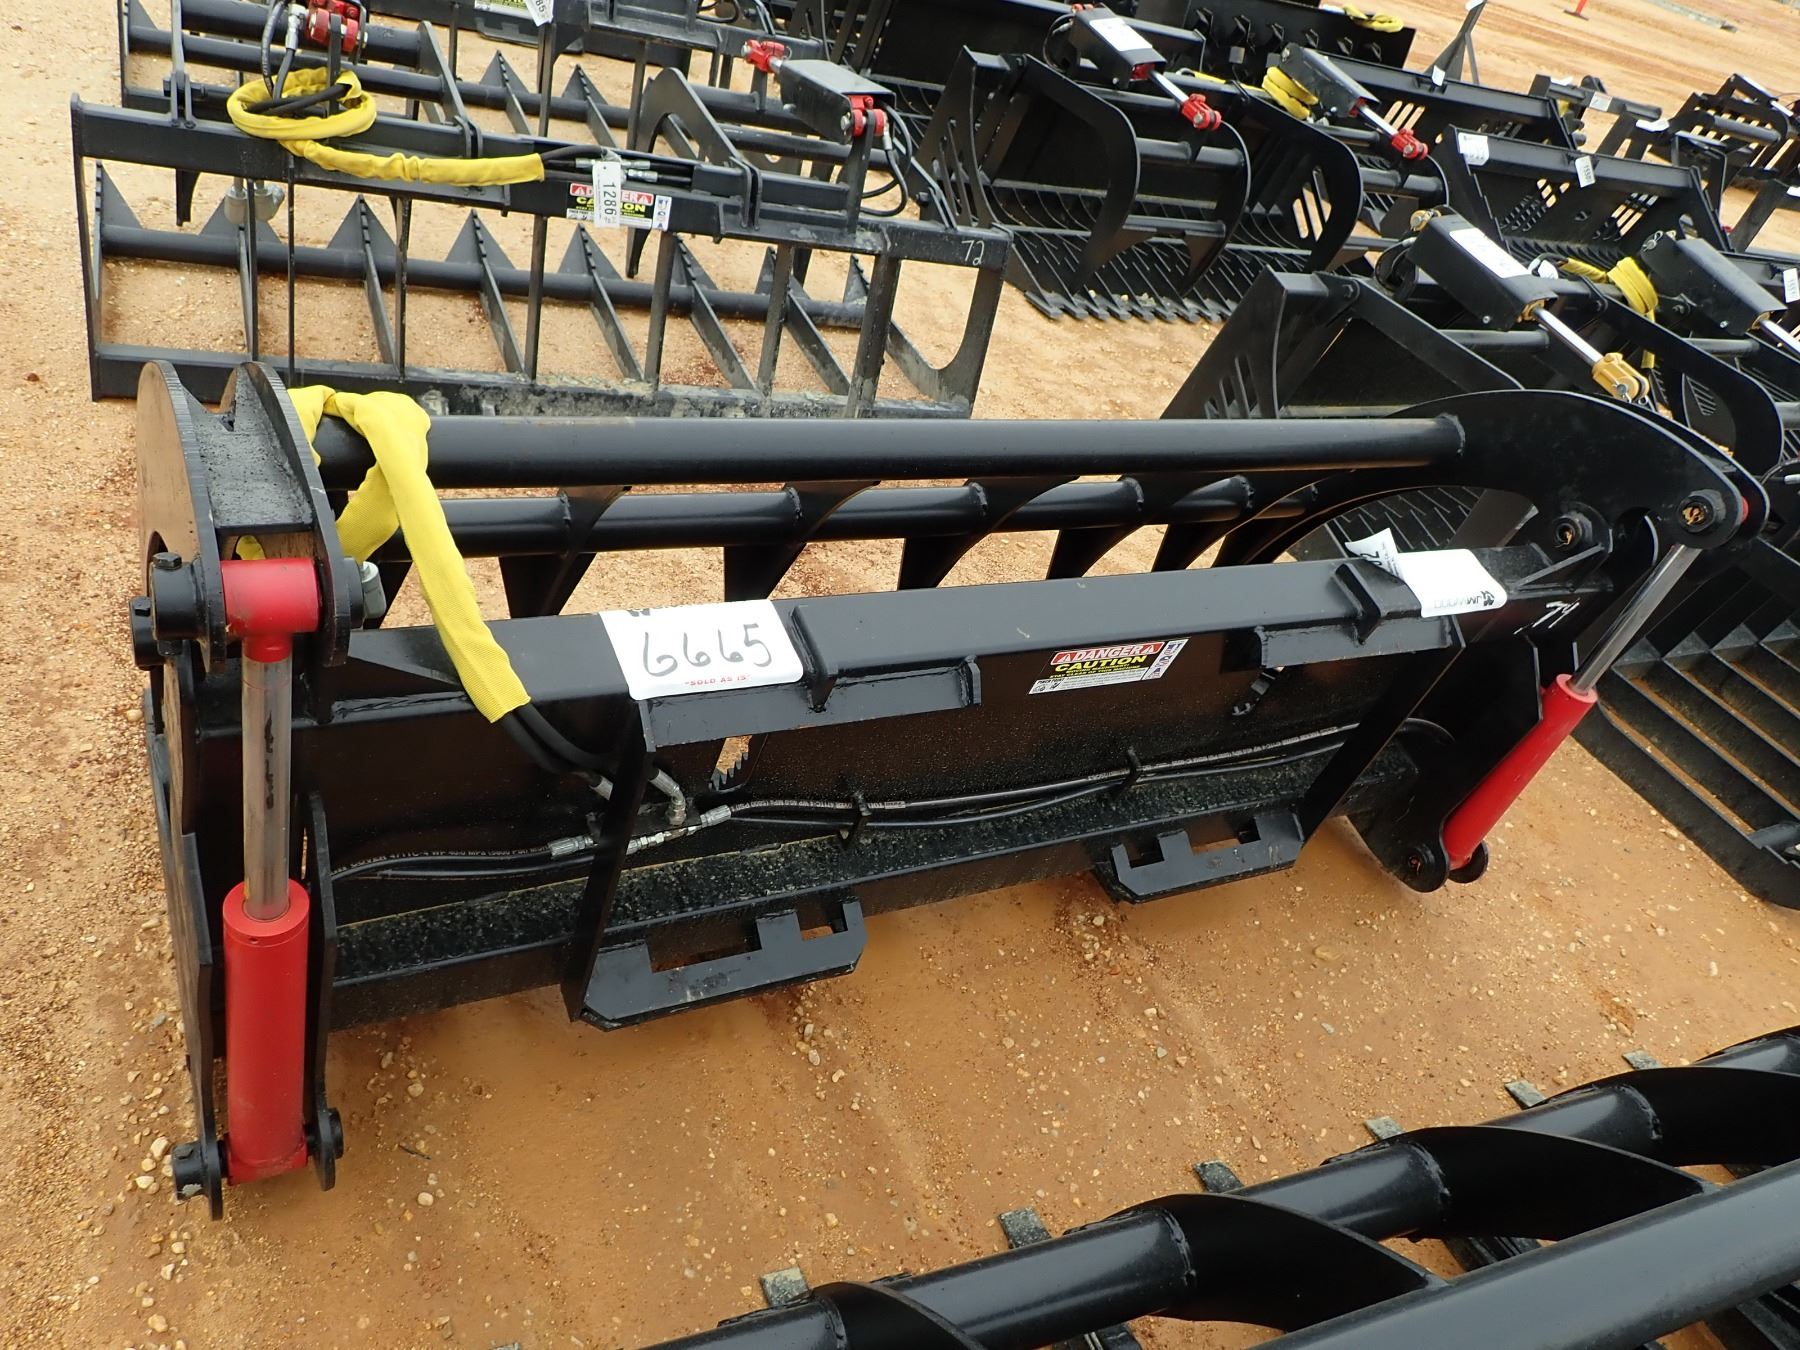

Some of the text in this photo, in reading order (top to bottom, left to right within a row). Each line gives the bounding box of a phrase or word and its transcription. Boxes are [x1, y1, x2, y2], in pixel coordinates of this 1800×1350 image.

[576, 196, 646, 212] CAION
[602, 182, 617, 216] 1286
[961, 240, 985, 265] 72
[643, 623, 772, 677] 6665
[1075, 645, 1143, 662] DANGER
[1055, 655, 1148, 672] CAUTION
[720, 675, 733, 683] AS
